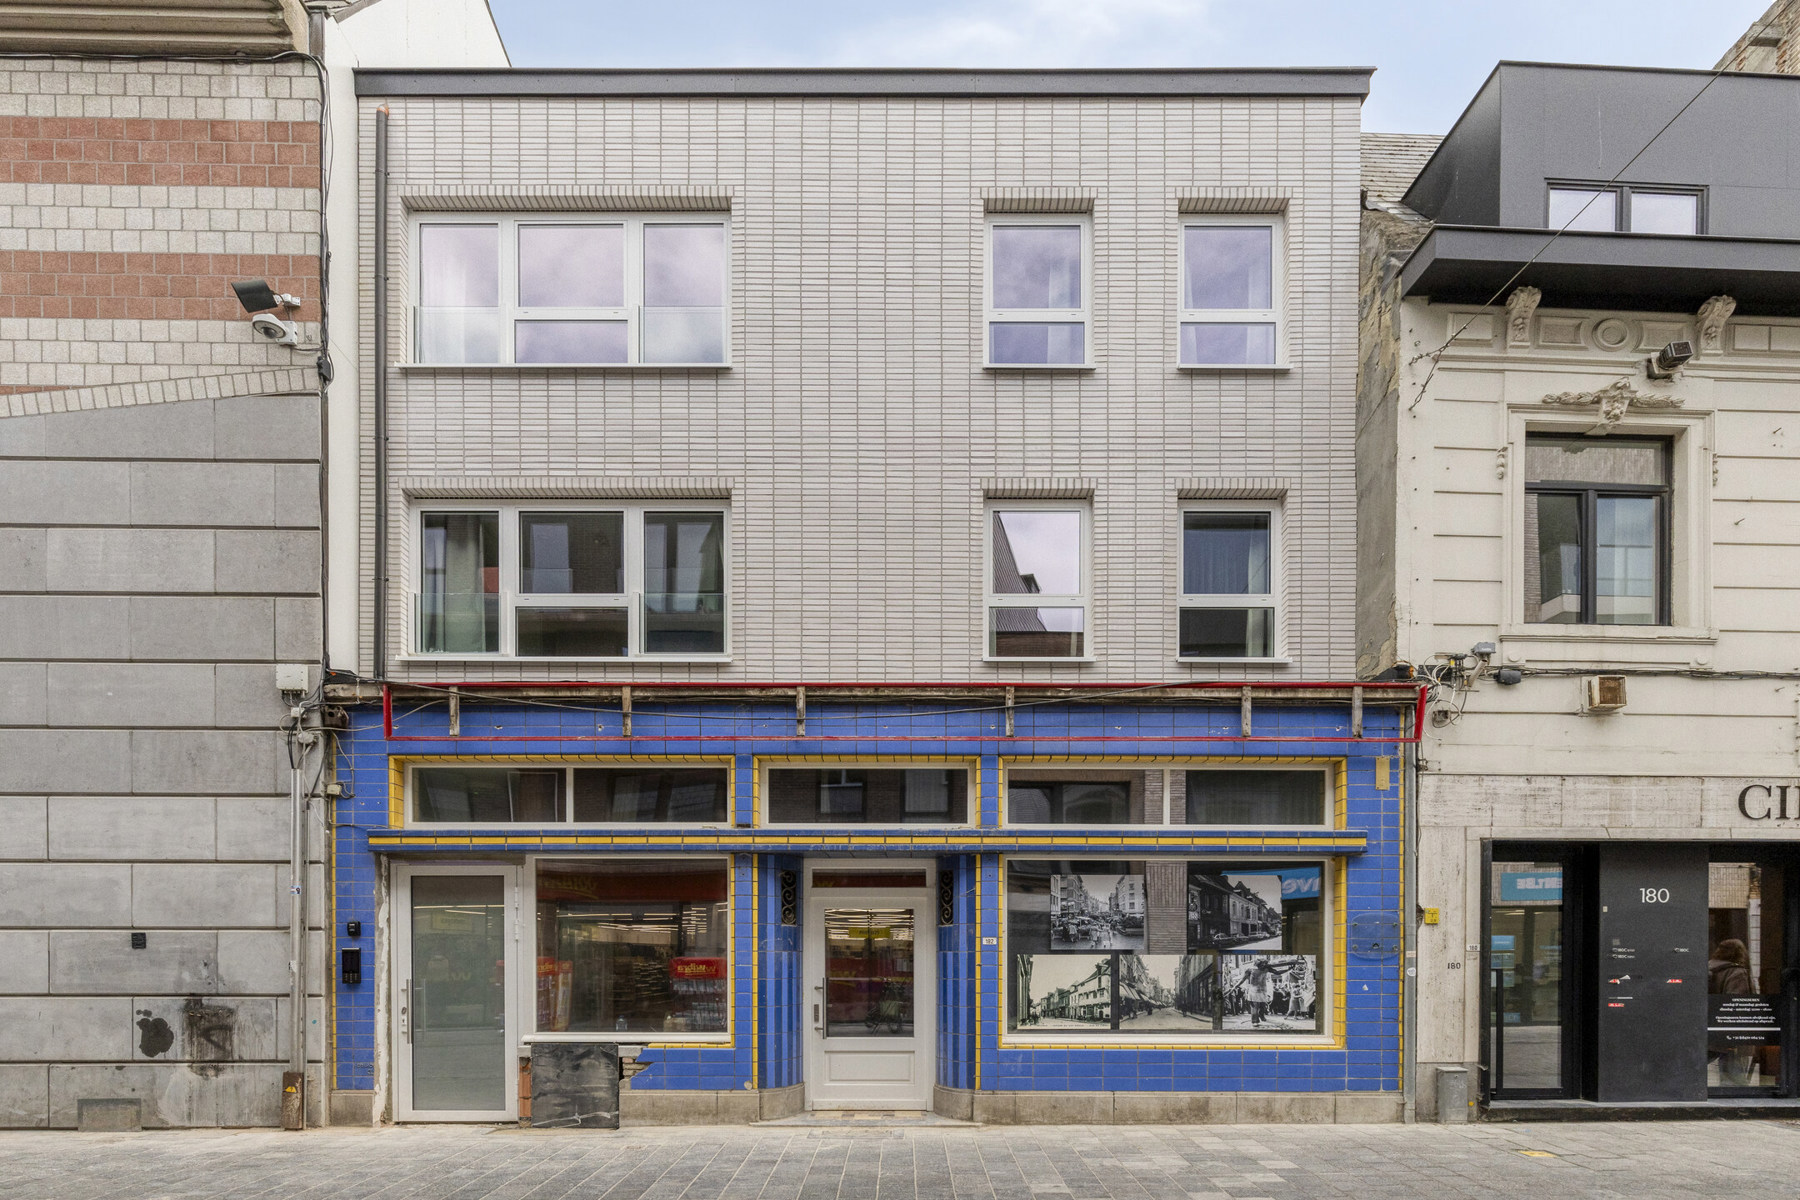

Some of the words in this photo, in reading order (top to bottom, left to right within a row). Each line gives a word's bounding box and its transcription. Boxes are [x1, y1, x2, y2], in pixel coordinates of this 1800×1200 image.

[1738, 784, 1800, 820] CI
[1639, 888, 1670, 904] 180
[1447, 962, 1462, 970] 180
